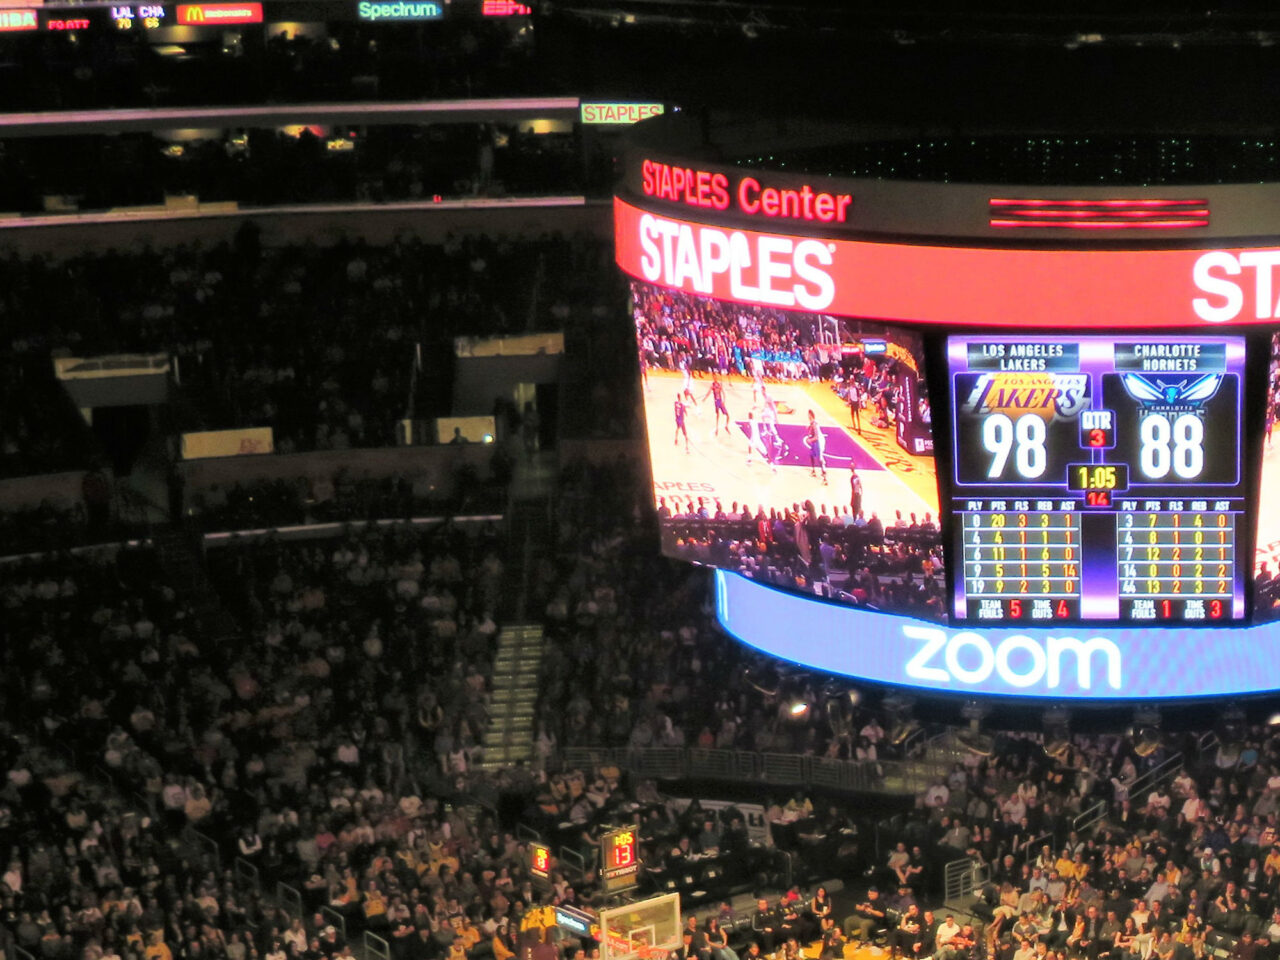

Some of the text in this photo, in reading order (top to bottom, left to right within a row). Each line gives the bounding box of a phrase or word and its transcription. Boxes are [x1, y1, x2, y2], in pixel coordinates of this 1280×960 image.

[111, 6, 164, 19] LAL CHA
[359, 1, 438, 20] Spectrum
[584, 105, 660, 122] STAPLES
[642, 159, 852, 222] STAPLES Center
[639, 213, 836, 311] STAPLES
[982, 344, 1063, 357] LOS ANGELES
[1134, 345, 1200, 357] CHARLOTTE
[1000, 359, 1046, 371] LAKERS
[1143, 359, 1197, 371] HORNETS
[973, 378, 1080, 417] LAKERS
[1083, 412, 1111, 429] QTR
[1089, 429, 1106, 447] 3
[983, 413, 1047, 478] 98
[1140, 413, 1203, 479] 88
[1079, 467, 1116, 489] 1:05
[968, 501, 1076, 511] PLY PTS FLS REB AST
[1088, 493, 1109, 506] 14
[1122, 501, 1230, 511] PLY PTS FLS REB AST
[991, 514, 1005, 528] 20
[1019, 514, 1027, 528] 3
[1041, 514, 1049, 528] 3
[1065, 514, 1071, 528] 1
[1126, 514, 1133, 528] 3
[1149, 514, 1157, 528] 7
[1173, 514, 1179, 528] 1
[1194, 514, 1203, 528] 4
[973, 531, 1072, 544] 4 4 1 1 1
[1125, 531, 1133, 544] 4
[1173, 531, 1179, 544] 1
[1219, 531, 1225, 544] 1
[974, 547, 981, 560] 6
[993, 547, 1005, 560] 11
[1020, 547, 1026, 560] 1
[1042, 547, 1049, 560] 6
[1126, 547, 1225, 560] 7 12 2 2 1
[974, 564, 1077, 577] 9 5 1 5 14
[1124, 564, 1136, 577] 14
[1195, 564, 1203, 577] 2
[1218, 564, 1226, 577] 2
[972, 580, 984, 593] 19
[996, 580, 1003, 593] 9
[1020, 580, 1028, 593] 2
[1042, 580, 1050, 593] 3
[1123, 580, 1226, 593] 44 13 2 3 2
[981, 600, 1001, 608] TEAM
[1010, 600, 1022, 618] 5
[1033, 600, 1051, 608] TIME
[1057, 600, 1069, 618] 4
[1134, 600, 1154, 608] TEAM
[1162, 600, 1171, 618] 1
[1186, 600, 1204, 608] TIME
[1210, 600, 1222, 618] 3
[979, 609, 1004, 618] FOULS
[1032, 609, 1053, 618] OUTS
[1132, 609, 1156, 618] FOULS
[1185, 609, 1205, 618] OUTS
[902, 625, 1122, 690] zoom
[616, 844, 631, 865] 13
